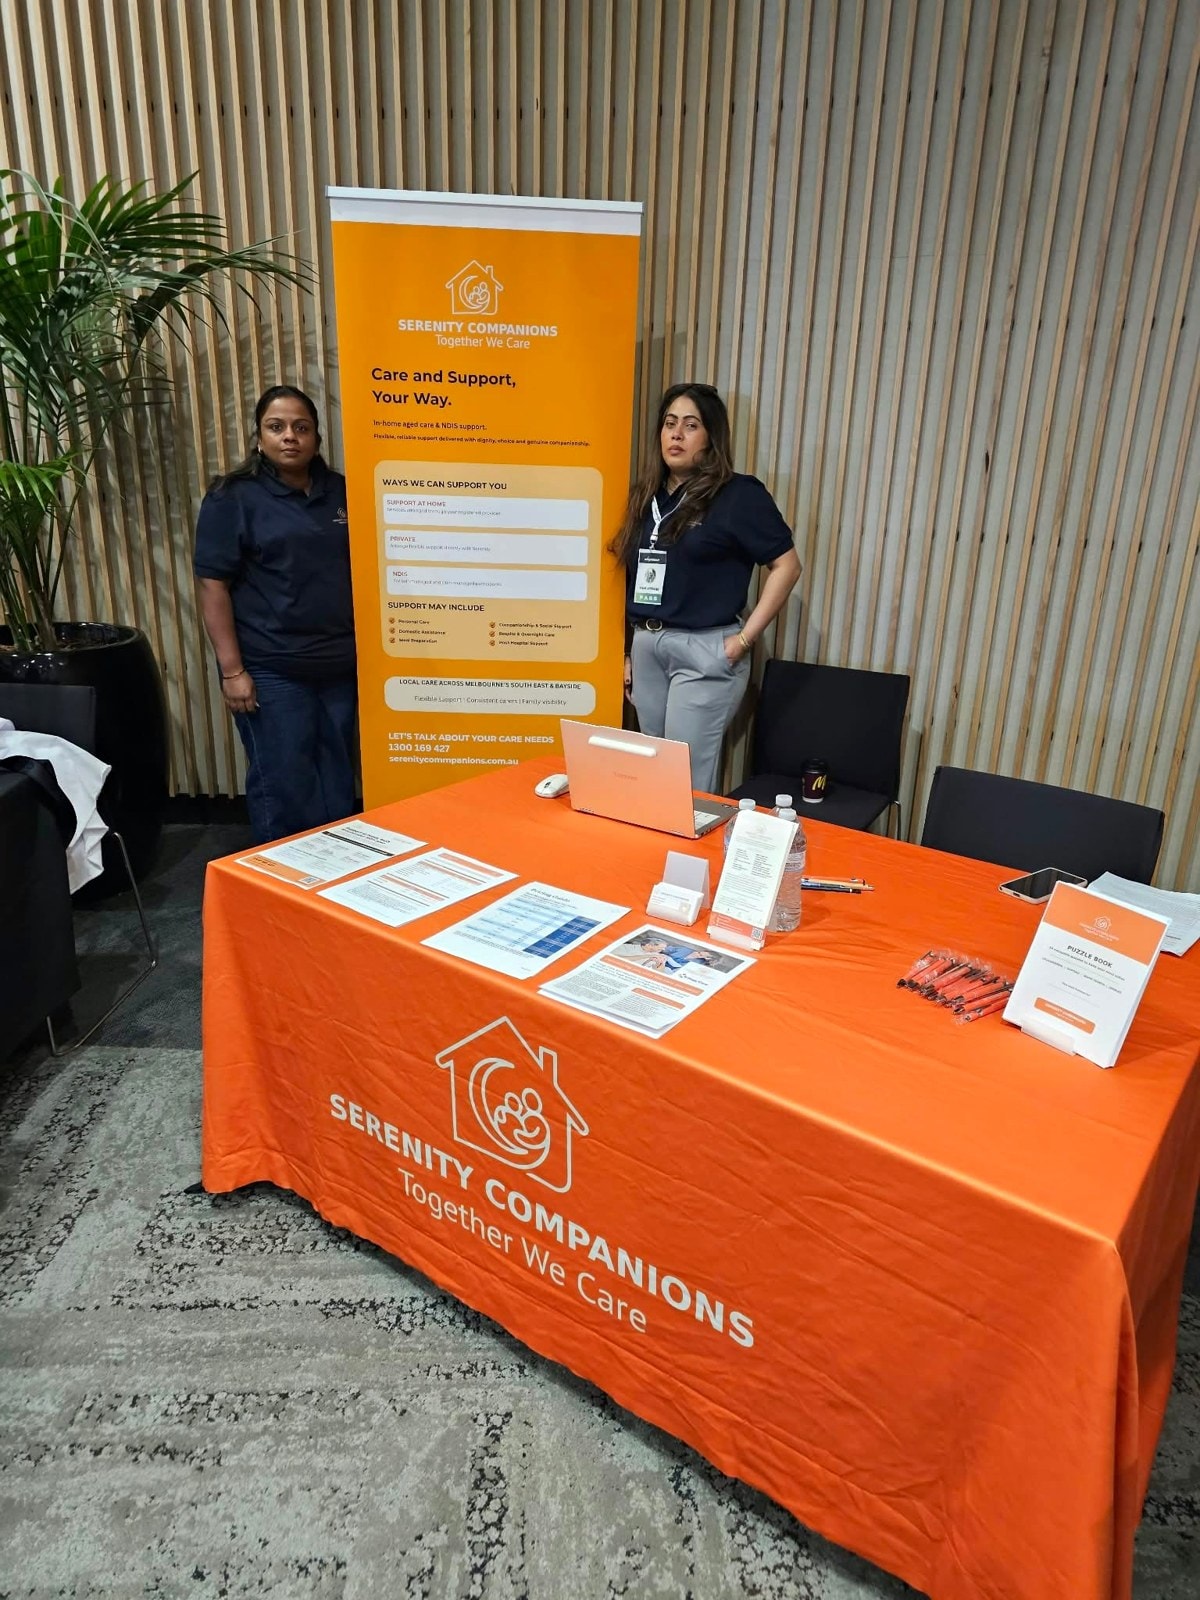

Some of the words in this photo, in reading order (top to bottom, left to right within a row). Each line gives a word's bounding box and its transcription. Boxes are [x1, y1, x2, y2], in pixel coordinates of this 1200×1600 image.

[398, 320, 464, 334] SERENITY
[467, 322, 558, 336] COMPANIONS
[436, 334, 483, 348] Together
[486, 336, 504, 348] We
[506, 337, 530, 349] Care
[371, 368, 408, 382] Care
[412, 369, 443, 383] and
[448, 370, 516, 388] Support,
[372, 390, 409, 404] Your
[414, 392, 452, 408] Way.
[382, 478, 408, 487] WAYS
[410, 480, 425, 488] WE
[426, 480, 445, 488] CAN
[447, 480, 487, 490] SUPPORT
[489, 482, 507, 490] YOU
[388, 602, 426, 610] SUPPORT
[1067, 945, 1092, 960] PUZZLE
[1094, 956, 1113, 968] BOOK
[330, 1093, 474, 1189] SERENITY
[486, 1179, 755, 1348] COMPANIONS
[398, 1168, 512, 1254] Together
[522, 1236, 566, 1286] We
[577, 1272, 648, 1334] Care
